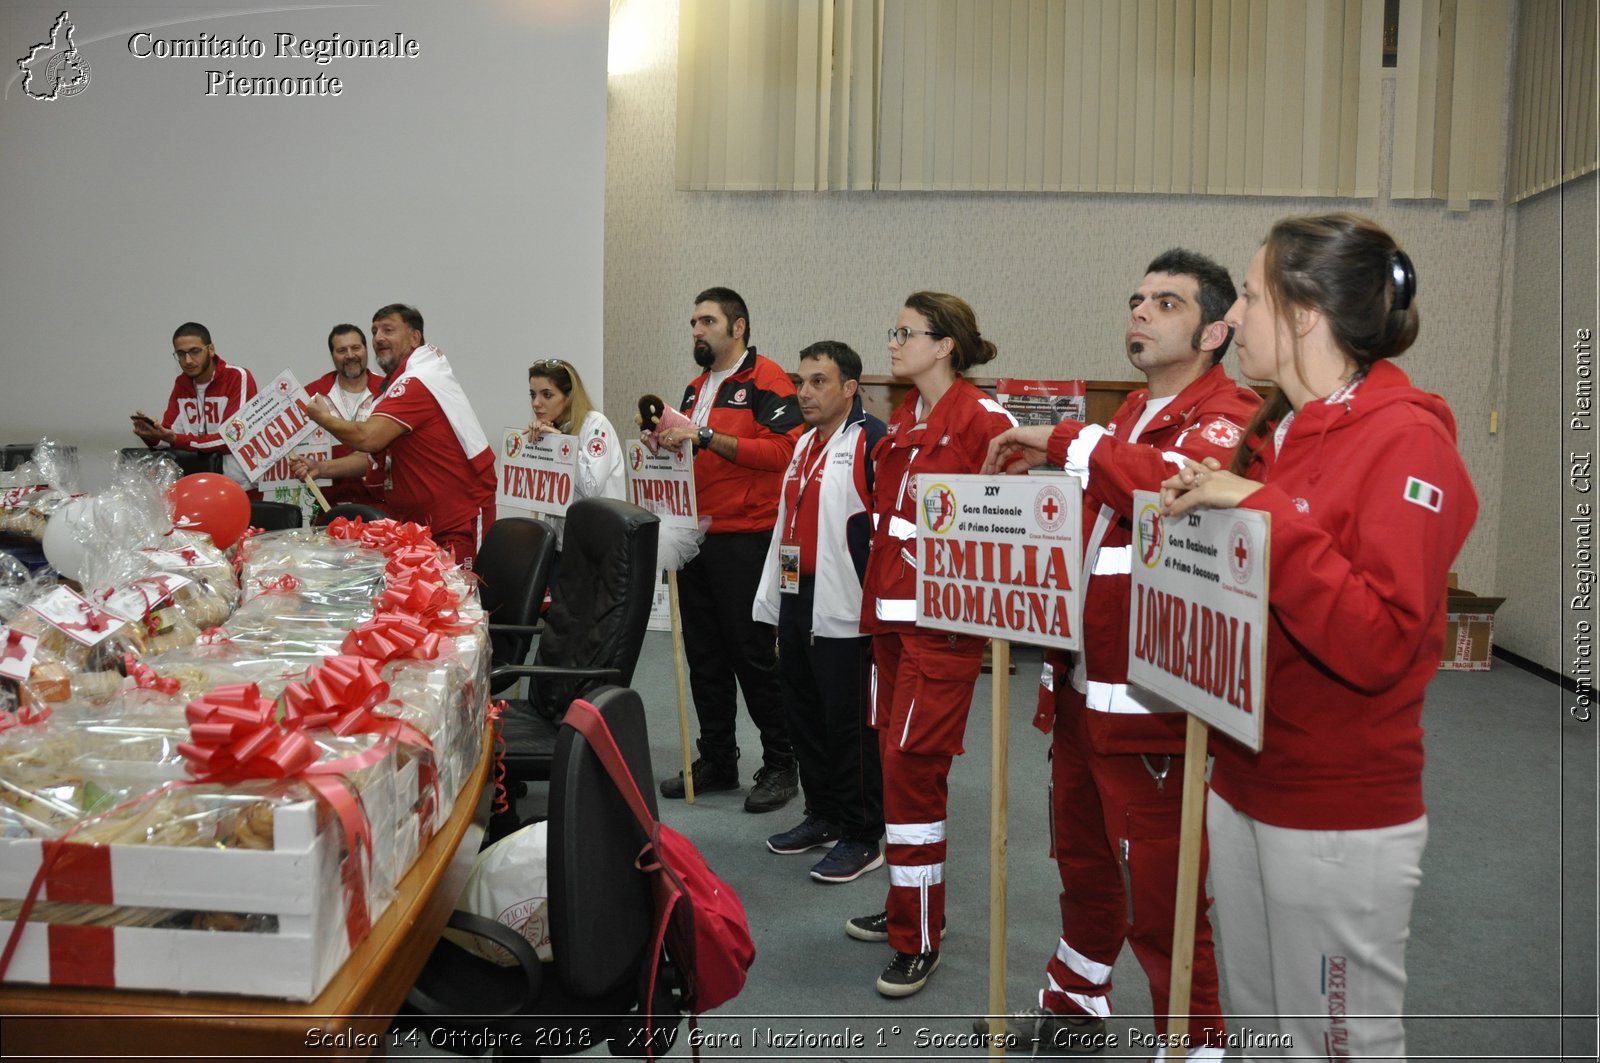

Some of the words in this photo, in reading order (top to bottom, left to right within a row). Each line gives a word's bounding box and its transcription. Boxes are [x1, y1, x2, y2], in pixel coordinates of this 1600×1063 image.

[184, 401, 221, 425] CRI
[238, 398, 309, 471] PUGLIA
[503, 464, 571, 506] VENETO
[985, 486, 1000, 496] XXV
[963, 504, 980, 514] Gara
[982, 506, 1023, 517] Nazionale
[1187, 513, 1202, 528] XXV
[958, 522, 967, 531] di
[967, 523, 989, 534] Primo
[991, 524, 1027, 535] Soccorso
[1168, 534, 1184, 549] Gara
[1186, 538, 1218, 558] Nazionale
[923, 537, 1073, 592] EMILIA
[1164, 557, 1171, 568] di
[1172, 558, 1191, 574] Primo
[1192, 564, 1220, 583] Soccorso
[922, 580, 1072, 639] ROMAGNA
[1135, 583, 1253, 715] LOMBARDIA
[1328, 955, 1347, 989] CROCE
